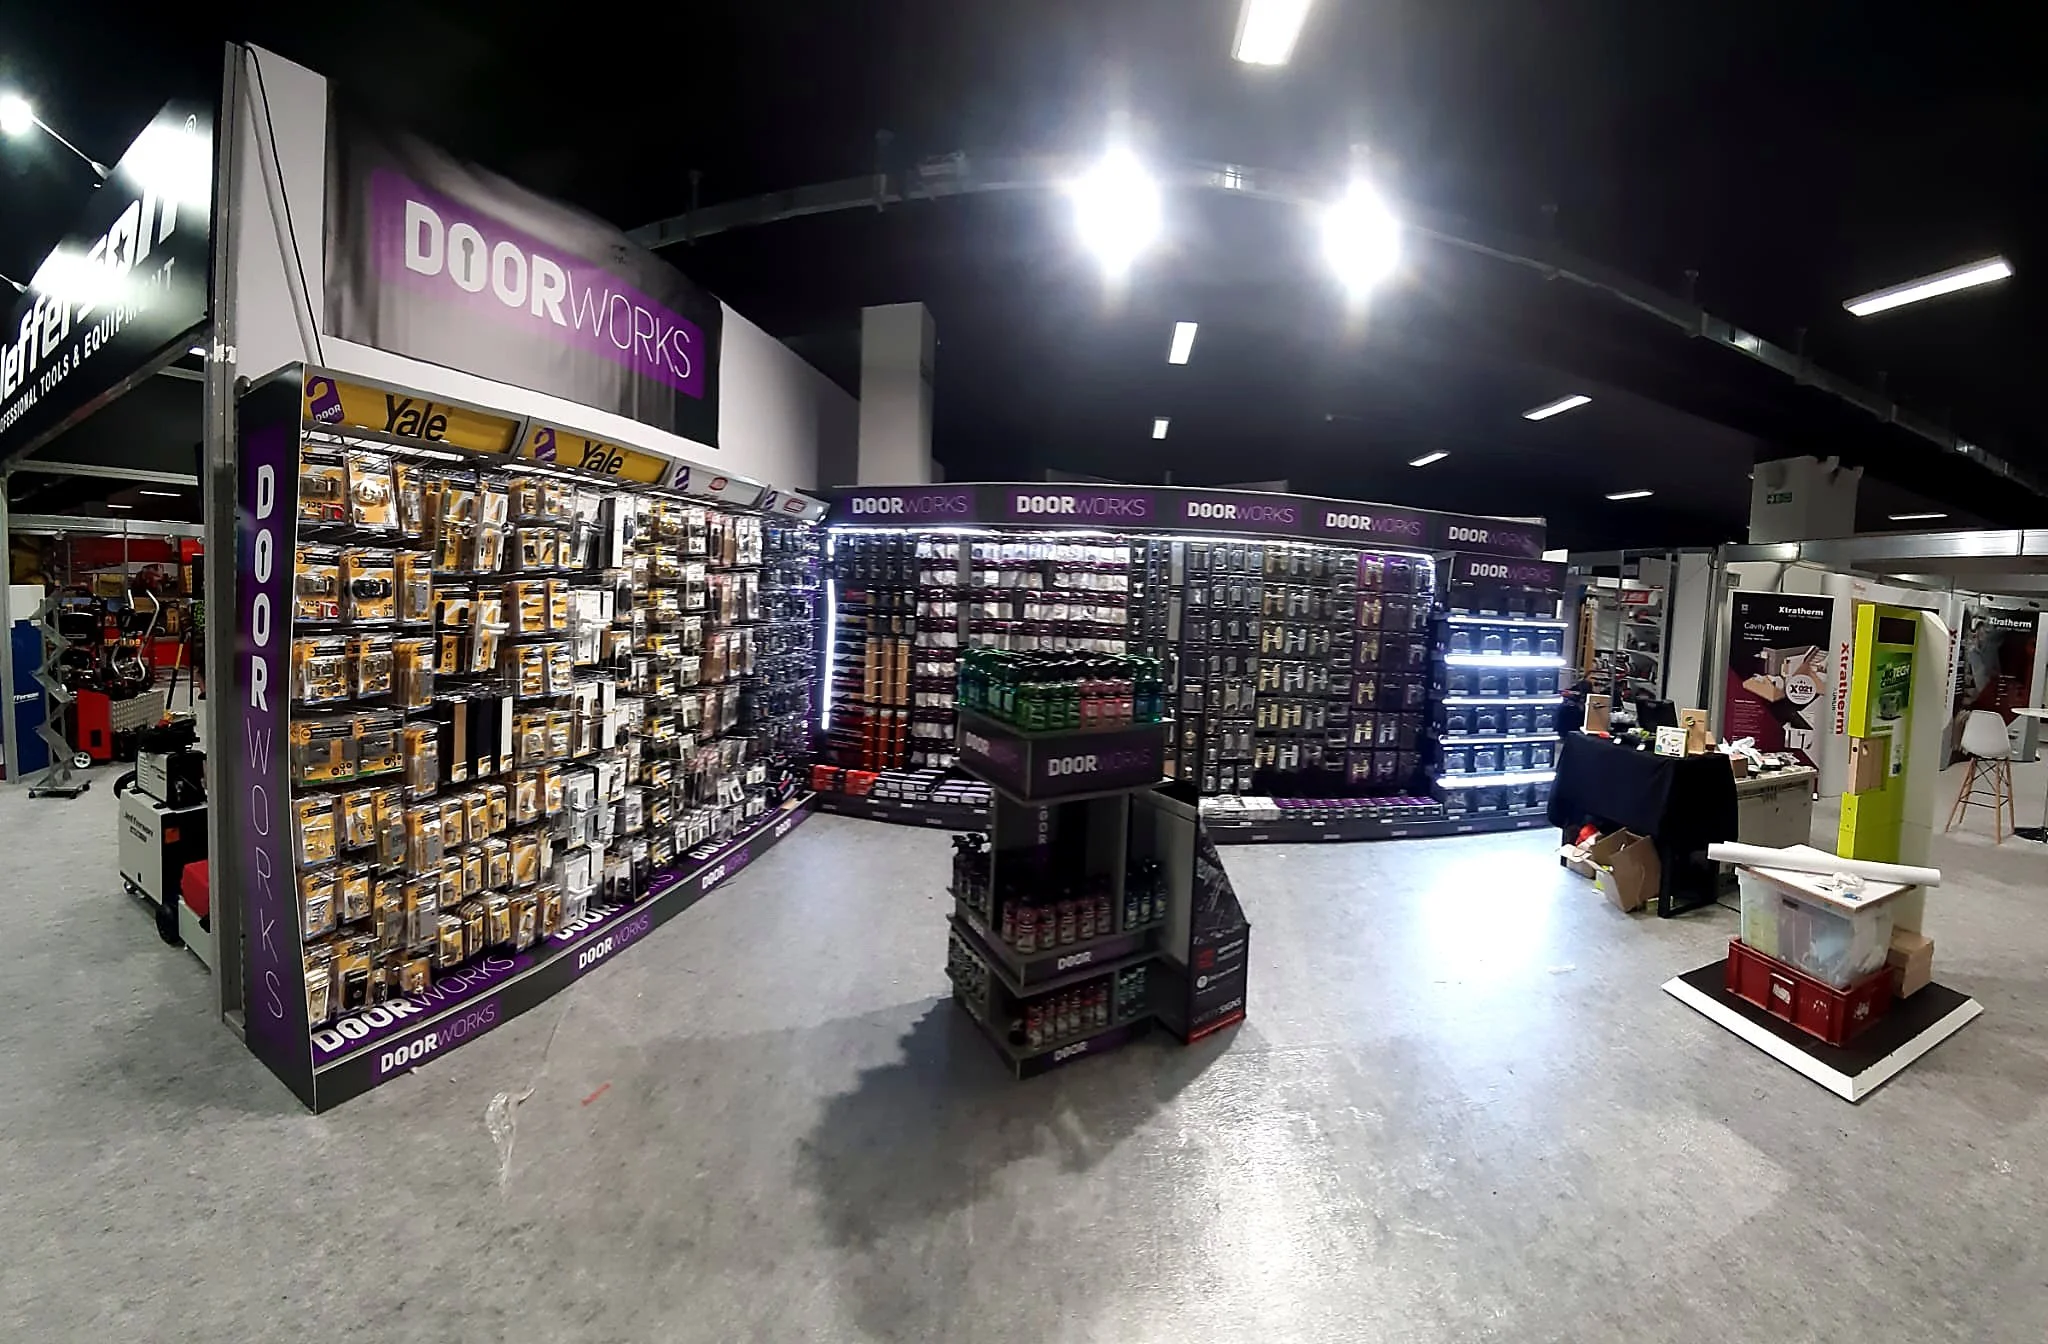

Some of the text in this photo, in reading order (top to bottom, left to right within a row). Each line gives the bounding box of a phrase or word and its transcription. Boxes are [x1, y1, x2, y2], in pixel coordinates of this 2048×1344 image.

[405, 199, 692, 378] DOORWORKS
[40, 353, 70, 397] TOOLS
[72, 343, 80, 368] &
[384, 394, 448, 442] Yale
[579, 440, 624, 474] Yale
[852, 496, 968, 514] DOORWORKS
[1016, 495, 1145, 516] DOORWORKS
[1187, 502, 1295, 523] DOORWORKS
[1325, 512, 1421, 536] DOORWORKS
[1778, 606, 1824, 616] Xtratherm
[1835, 642, 1850, 735] Xtratherm
[578, 914, 649, 970] DOORWORKS
[312, 953, 515, 1053] DOORWORKS
[380, 1003, 496, 1075] DOORWORKS
